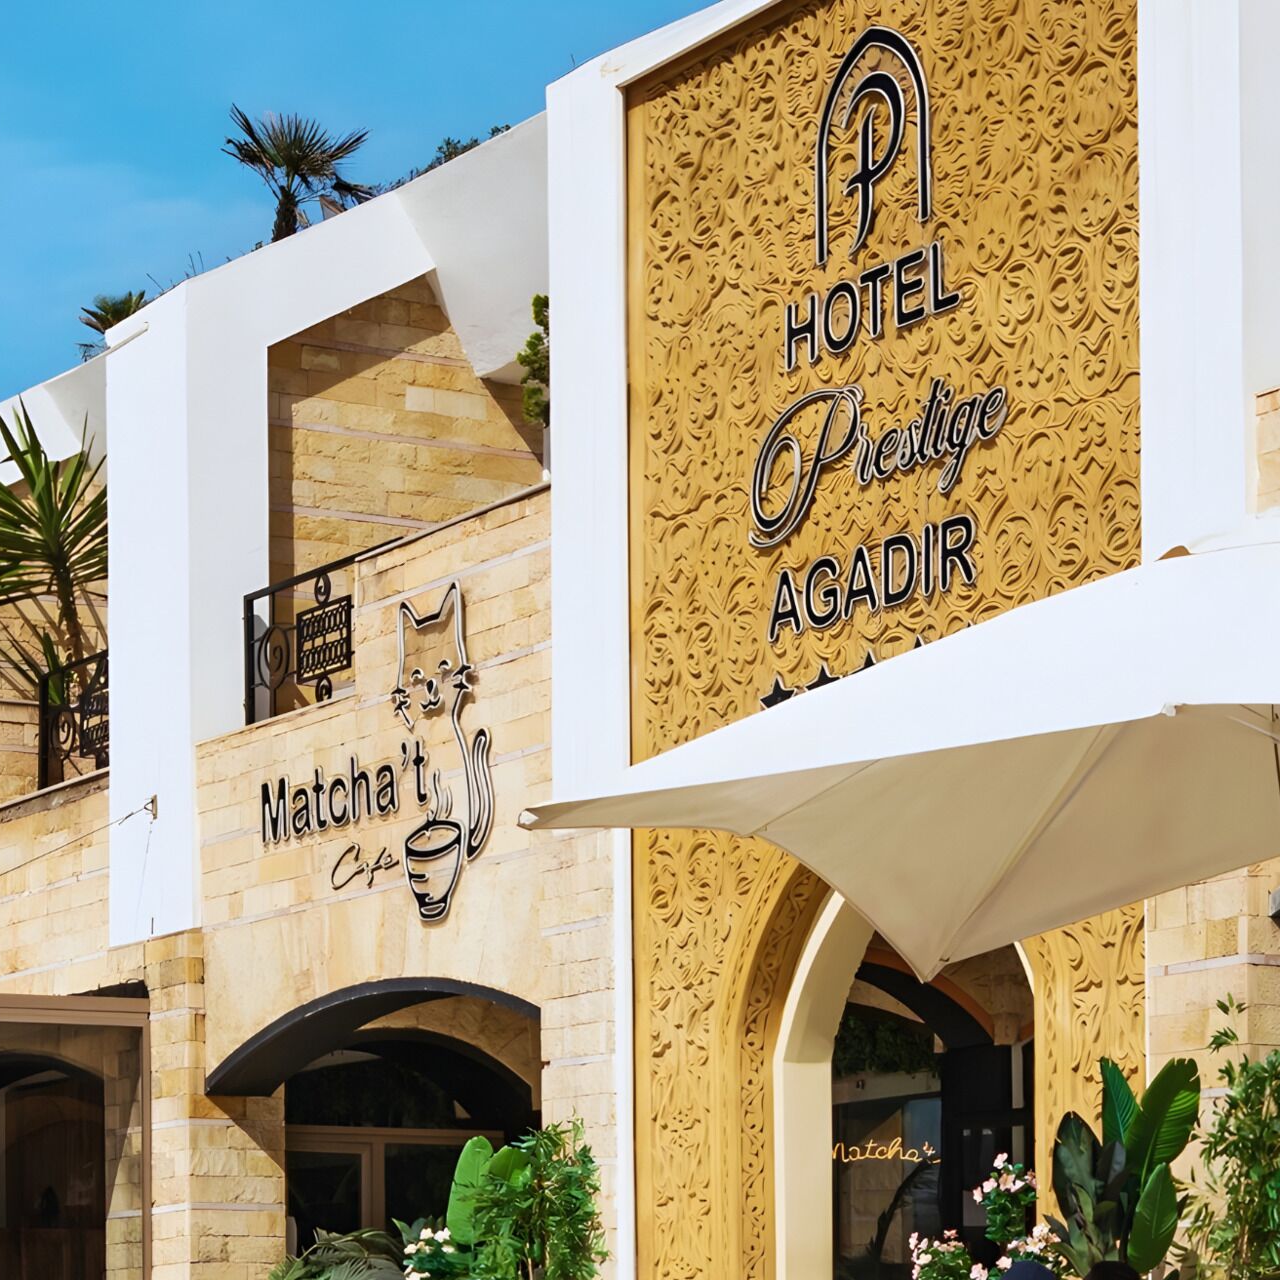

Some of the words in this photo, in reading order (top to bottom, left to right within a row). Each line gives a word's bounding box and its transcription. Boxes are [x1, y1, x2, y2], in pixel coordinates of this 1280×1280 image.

[783, 240, 962, 372] HOTEL
[749, 378, 1008, 550] Prestige
[767, 515, 978, 643] AGADIR
[261, 738, 429, 844] Matcha't
